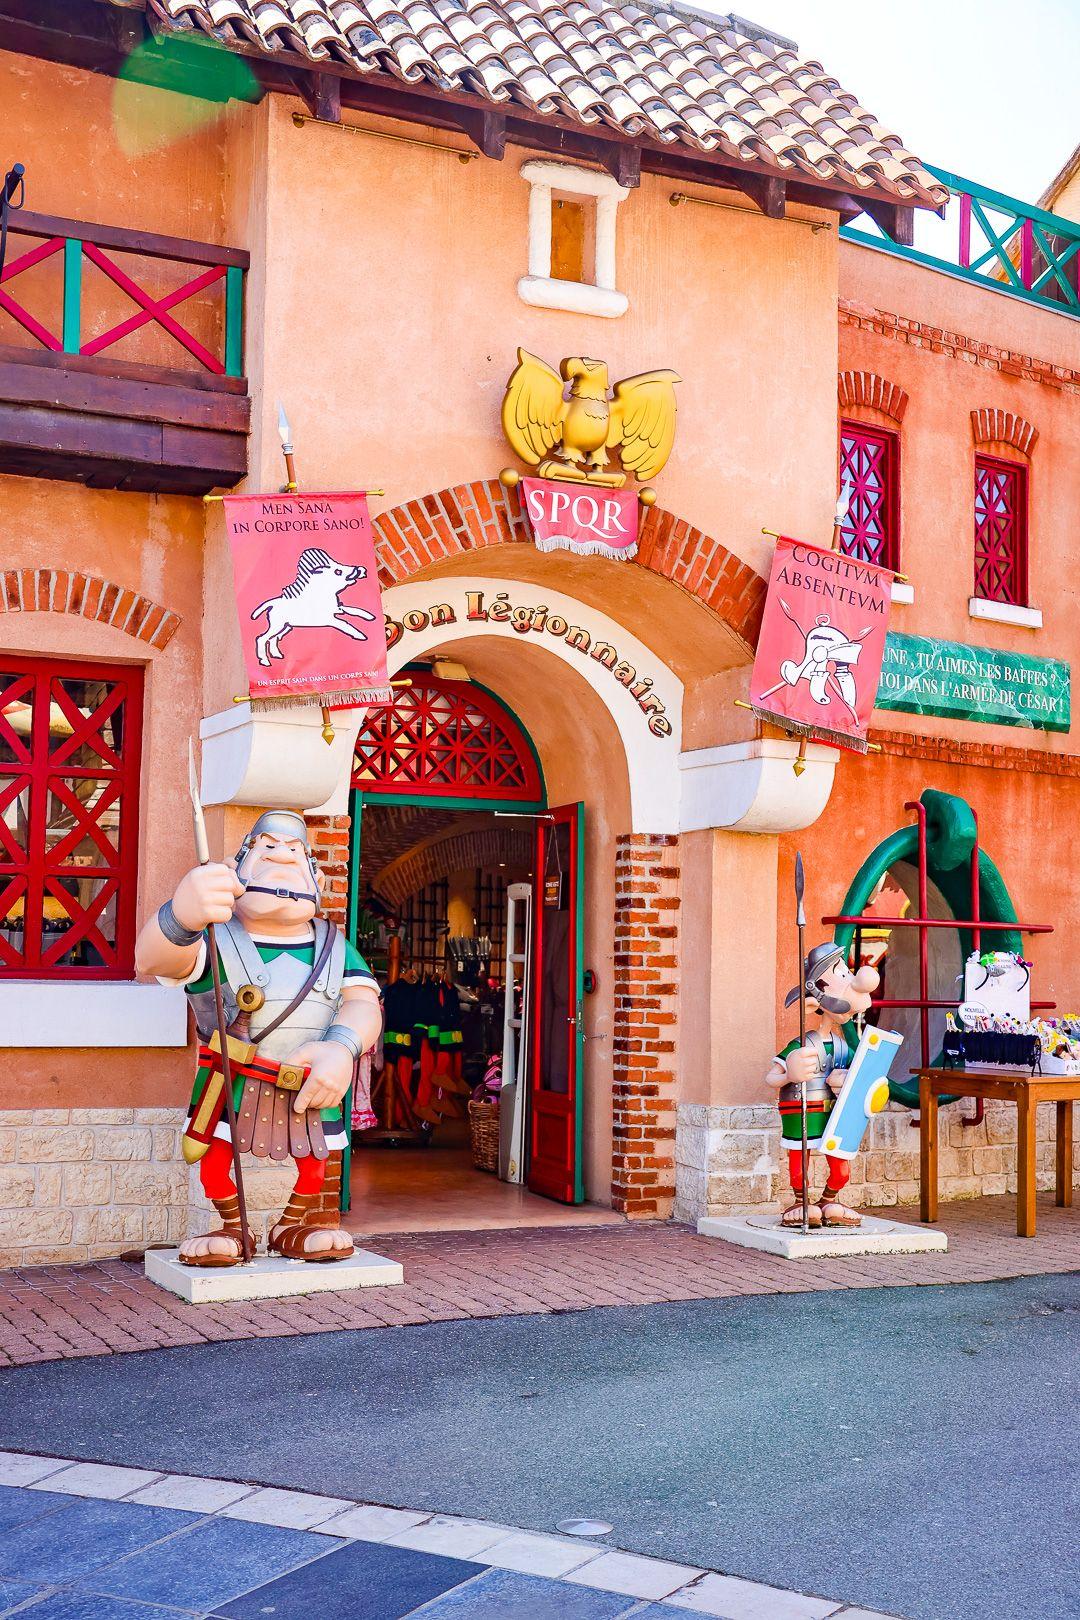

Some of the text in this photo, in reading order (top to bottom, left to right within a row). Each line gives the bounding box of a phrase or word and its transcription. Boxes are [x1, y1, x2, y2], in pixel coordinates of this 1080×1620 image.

[233, 517, 365, 534] IN CORPORE SANO!
[262, 501, 333, 515] MEN SANA
[529, 489, 630, 539] SPQR
[793, 545, 880, 588] COGITVM
[776, 566, 885, 614] ABSENTEVM
[340, 672, 363, 680] CORPS
[465, 591, 673, 738] Légionnaire
[916, 652, 934, 669] TU
[936, 656, 977, 676] AIMES
[979, 662, 1001, 680] LES
[1003, 666, 1048, 687] BAFFES
[904, 675, 938, 695] DANS
[941, 680, 998, 703] L'ARMÉE
[999, 689, 1016, 706] DE
[1018, 690, 1057, 712] CÉSAR
